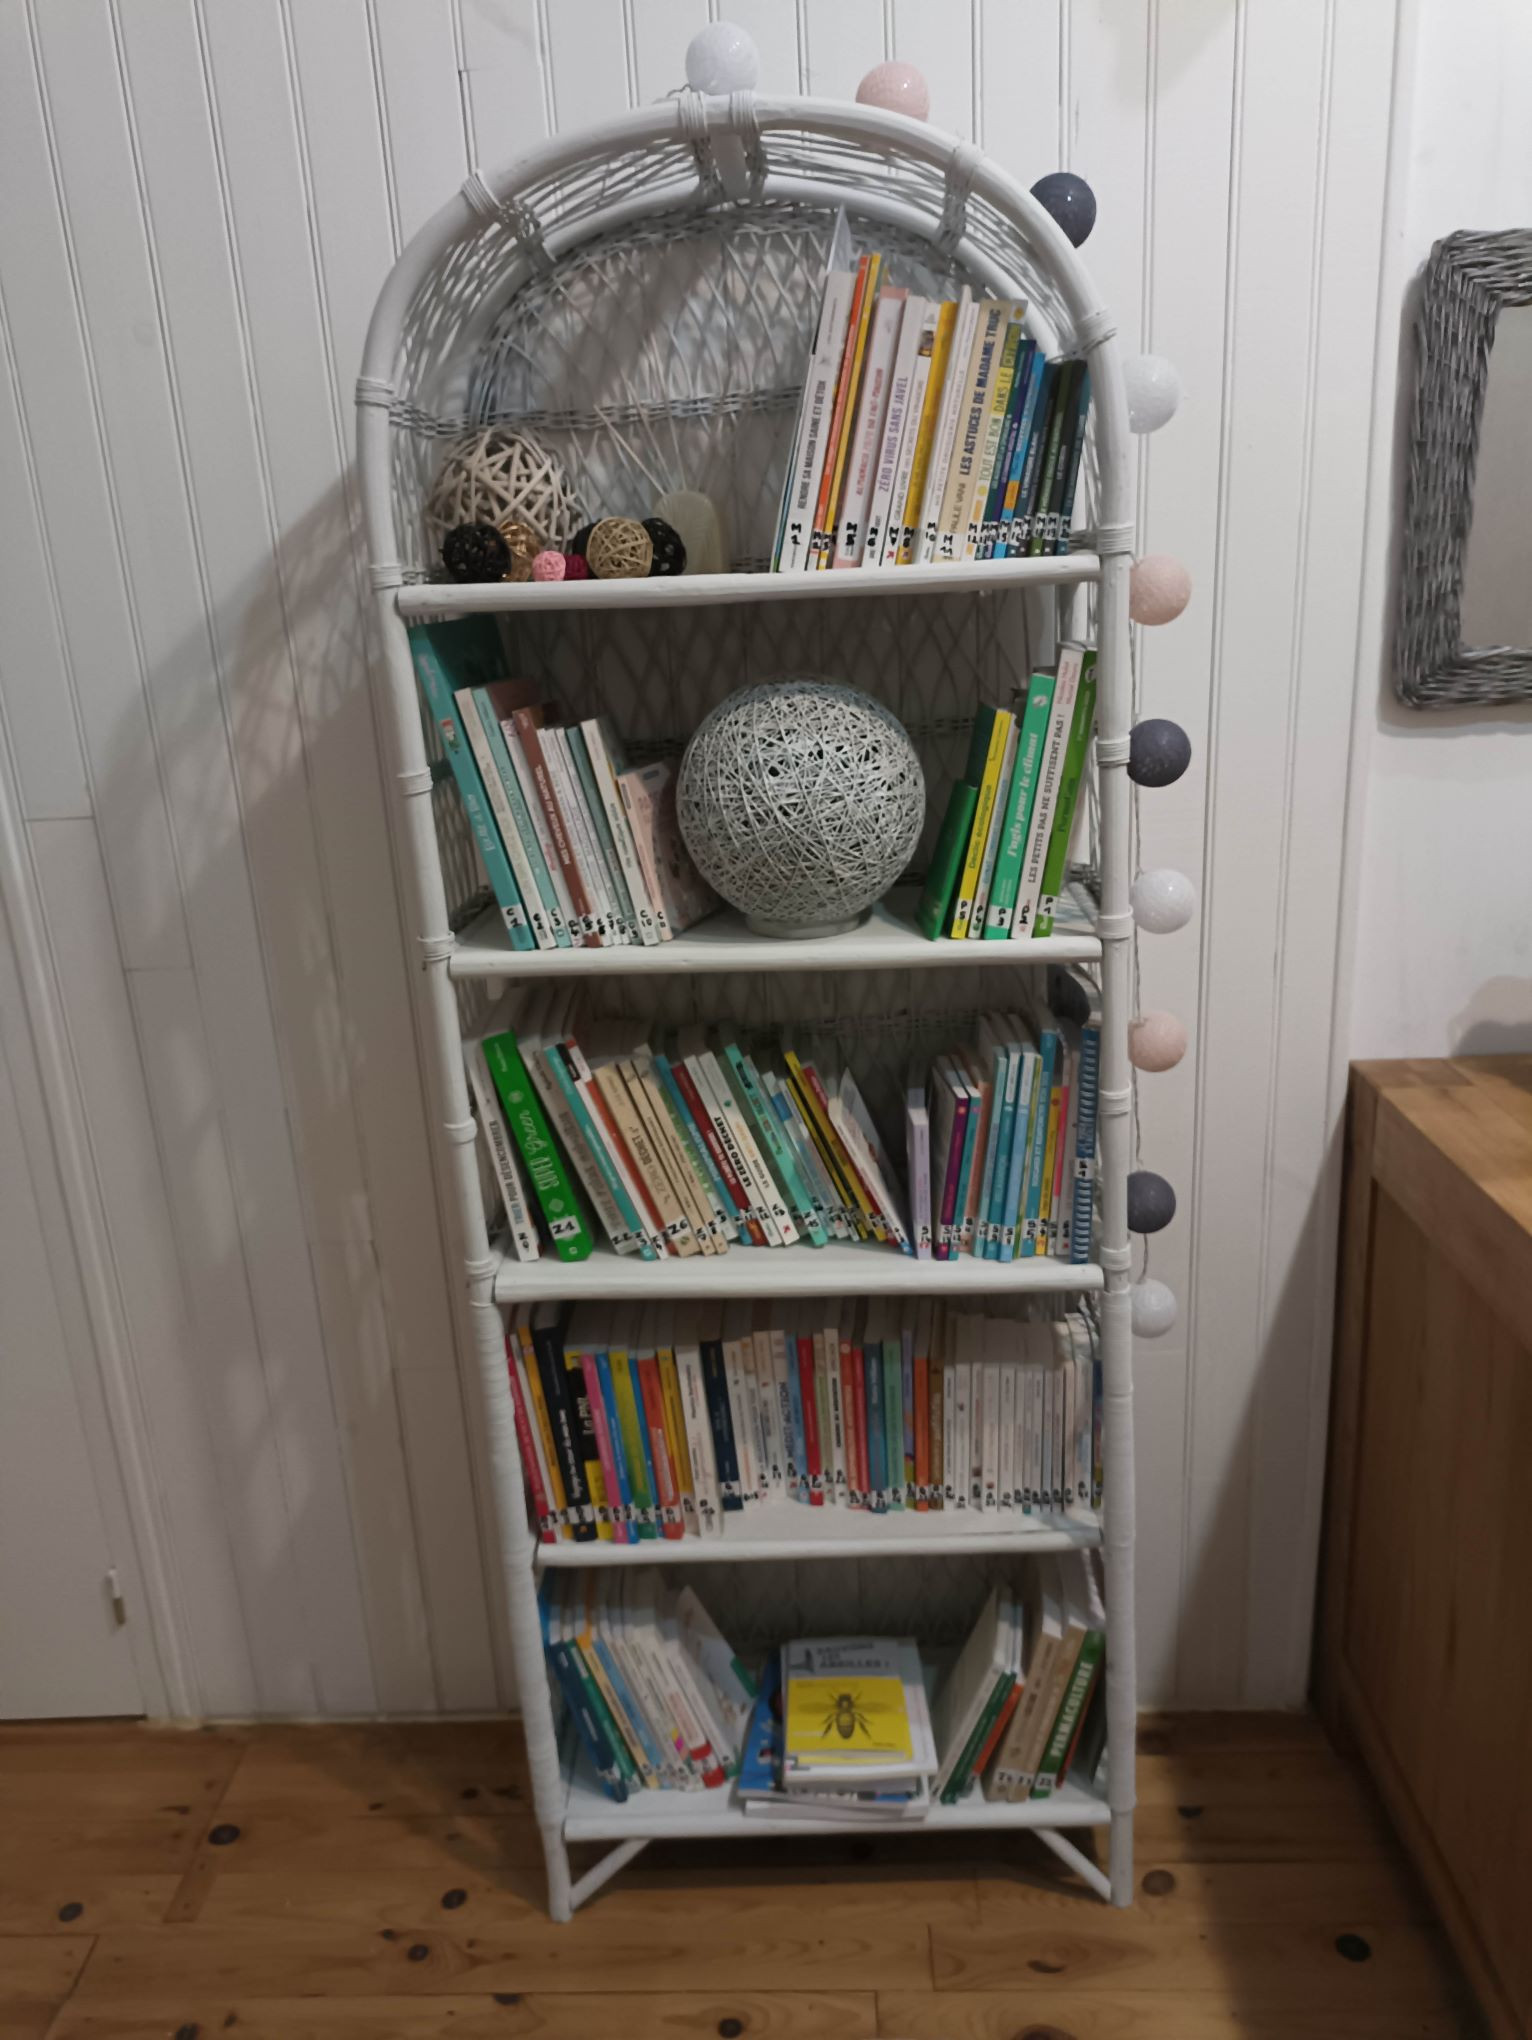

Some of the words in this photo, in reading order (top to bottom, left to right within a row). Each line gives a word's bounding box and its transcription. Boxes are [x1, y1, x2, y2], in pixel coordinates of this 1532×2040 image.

[985, 308, 1002, 339] TRUC
[975, 339, 996, 388] MADAME
[892, 374, 909, 406] JAVEL
[972, 390, 986, 405] DE
[887, 406, 903, 433] SANS
[961, 406, 983, 455] ASTUCES
[803, 439, 817, 468] MAISON
[881, 434, 898, 465] VIRUS
[801, 469, 812, 479] SA
[875, 465, 892, 492] ZÉRO
[957, 455, 973, 475] LES
[796, 480, 810, 510] RENDRE
[1052, 719, 1064, 739] PAS
[1019, 732, 1039, 774] climat
[1018, 775, 1031, 788] le
[1013, 788, 1031, 822] pour
[1039, 794, 1050, 810] NE
[1036, 811, 1047, 830] PAS
[1030, 831, 1044, 864] PETITS
[1026, 865, 1038, 883] LES
[740, 1174, 752, 1188] LE
[1048, 1660, 1095, 1759] PERMACULTURE
